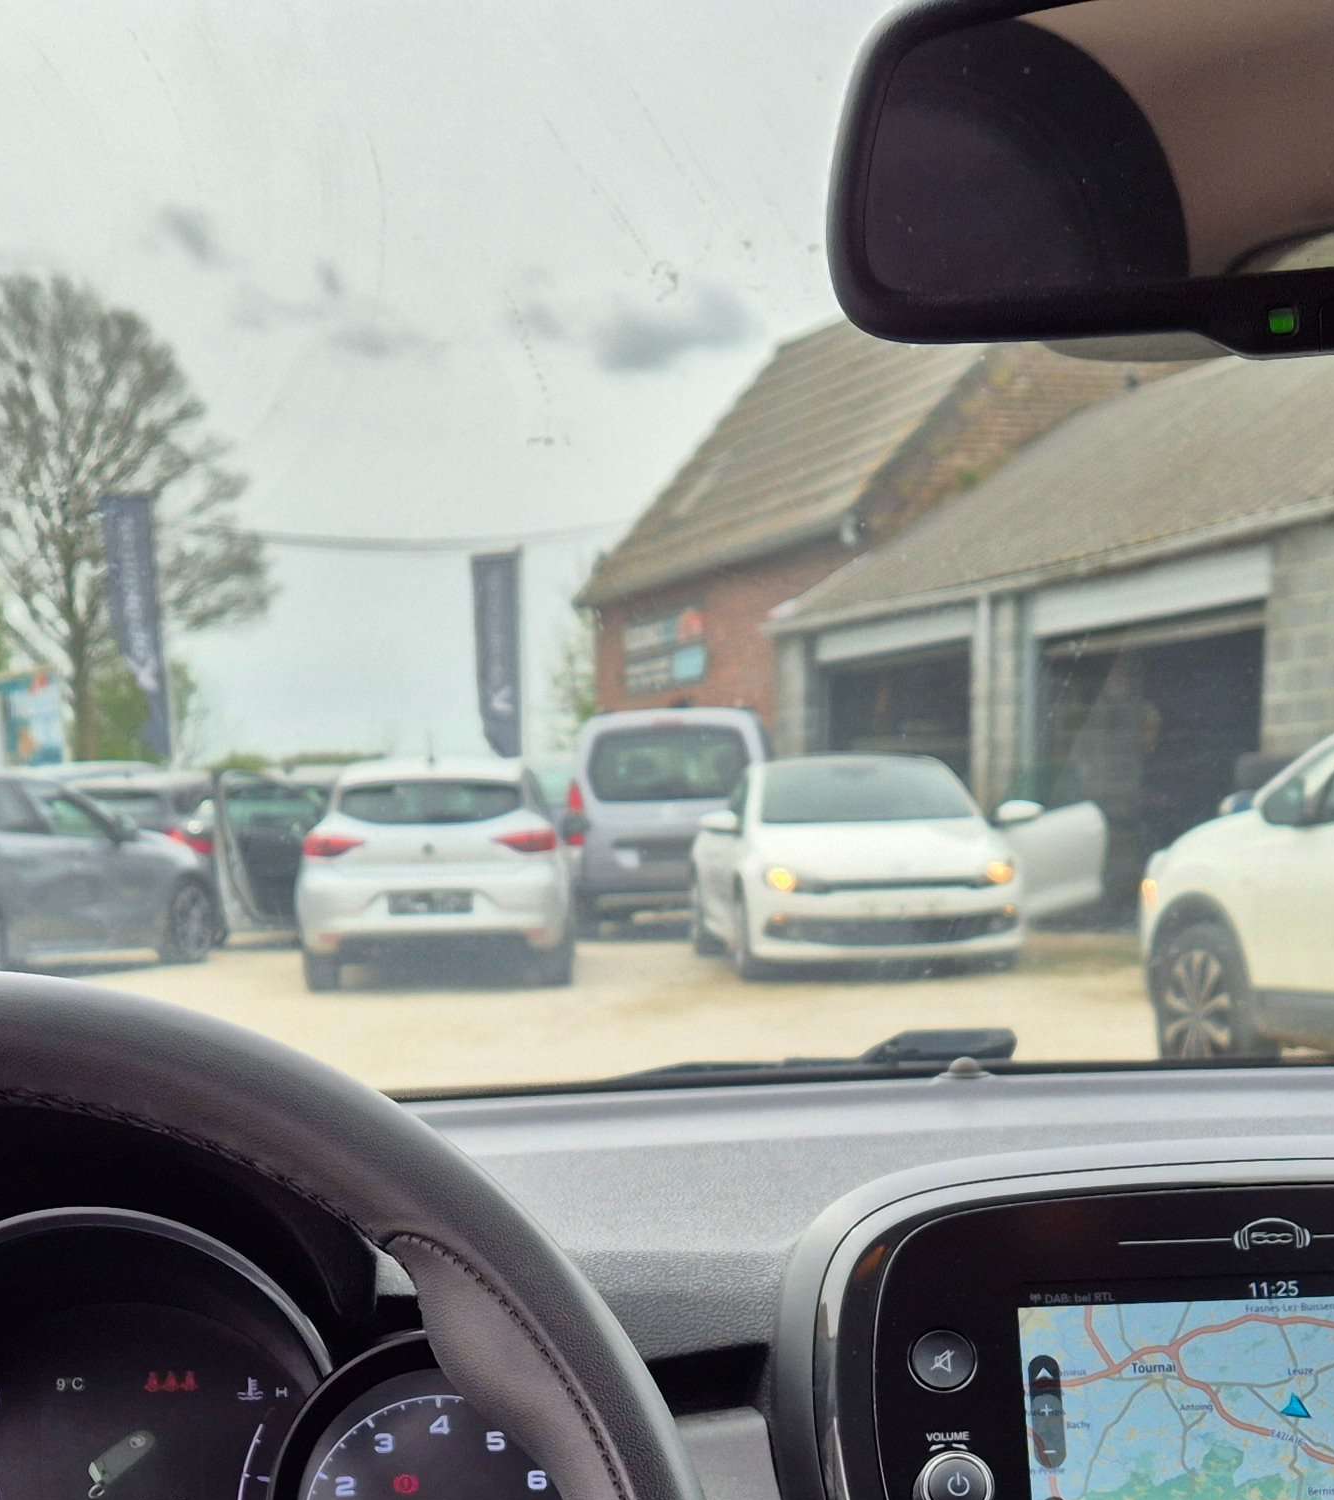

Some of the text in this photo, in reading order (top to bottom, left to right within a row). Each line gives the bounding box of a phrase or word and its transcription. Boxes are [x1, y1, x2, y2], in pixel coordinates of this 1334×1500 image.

[1248, 1280, 1299, 1298] 11:25
[1131, 1362, 1177, 1374] Tournai
[1288, 1368, 1315, 1377] Leuze
[275, 1386, 288, 1398] H
[429, 1415, 450, 1435] 4
[374, 1433, 395, 1453] 3
[486, 1431, 506, 1451] 5
[926, 1431, 970, 1443] VOLUME
[335, 1476, 356, 1497] 2
[527, 1470, 547, 1490] 6
